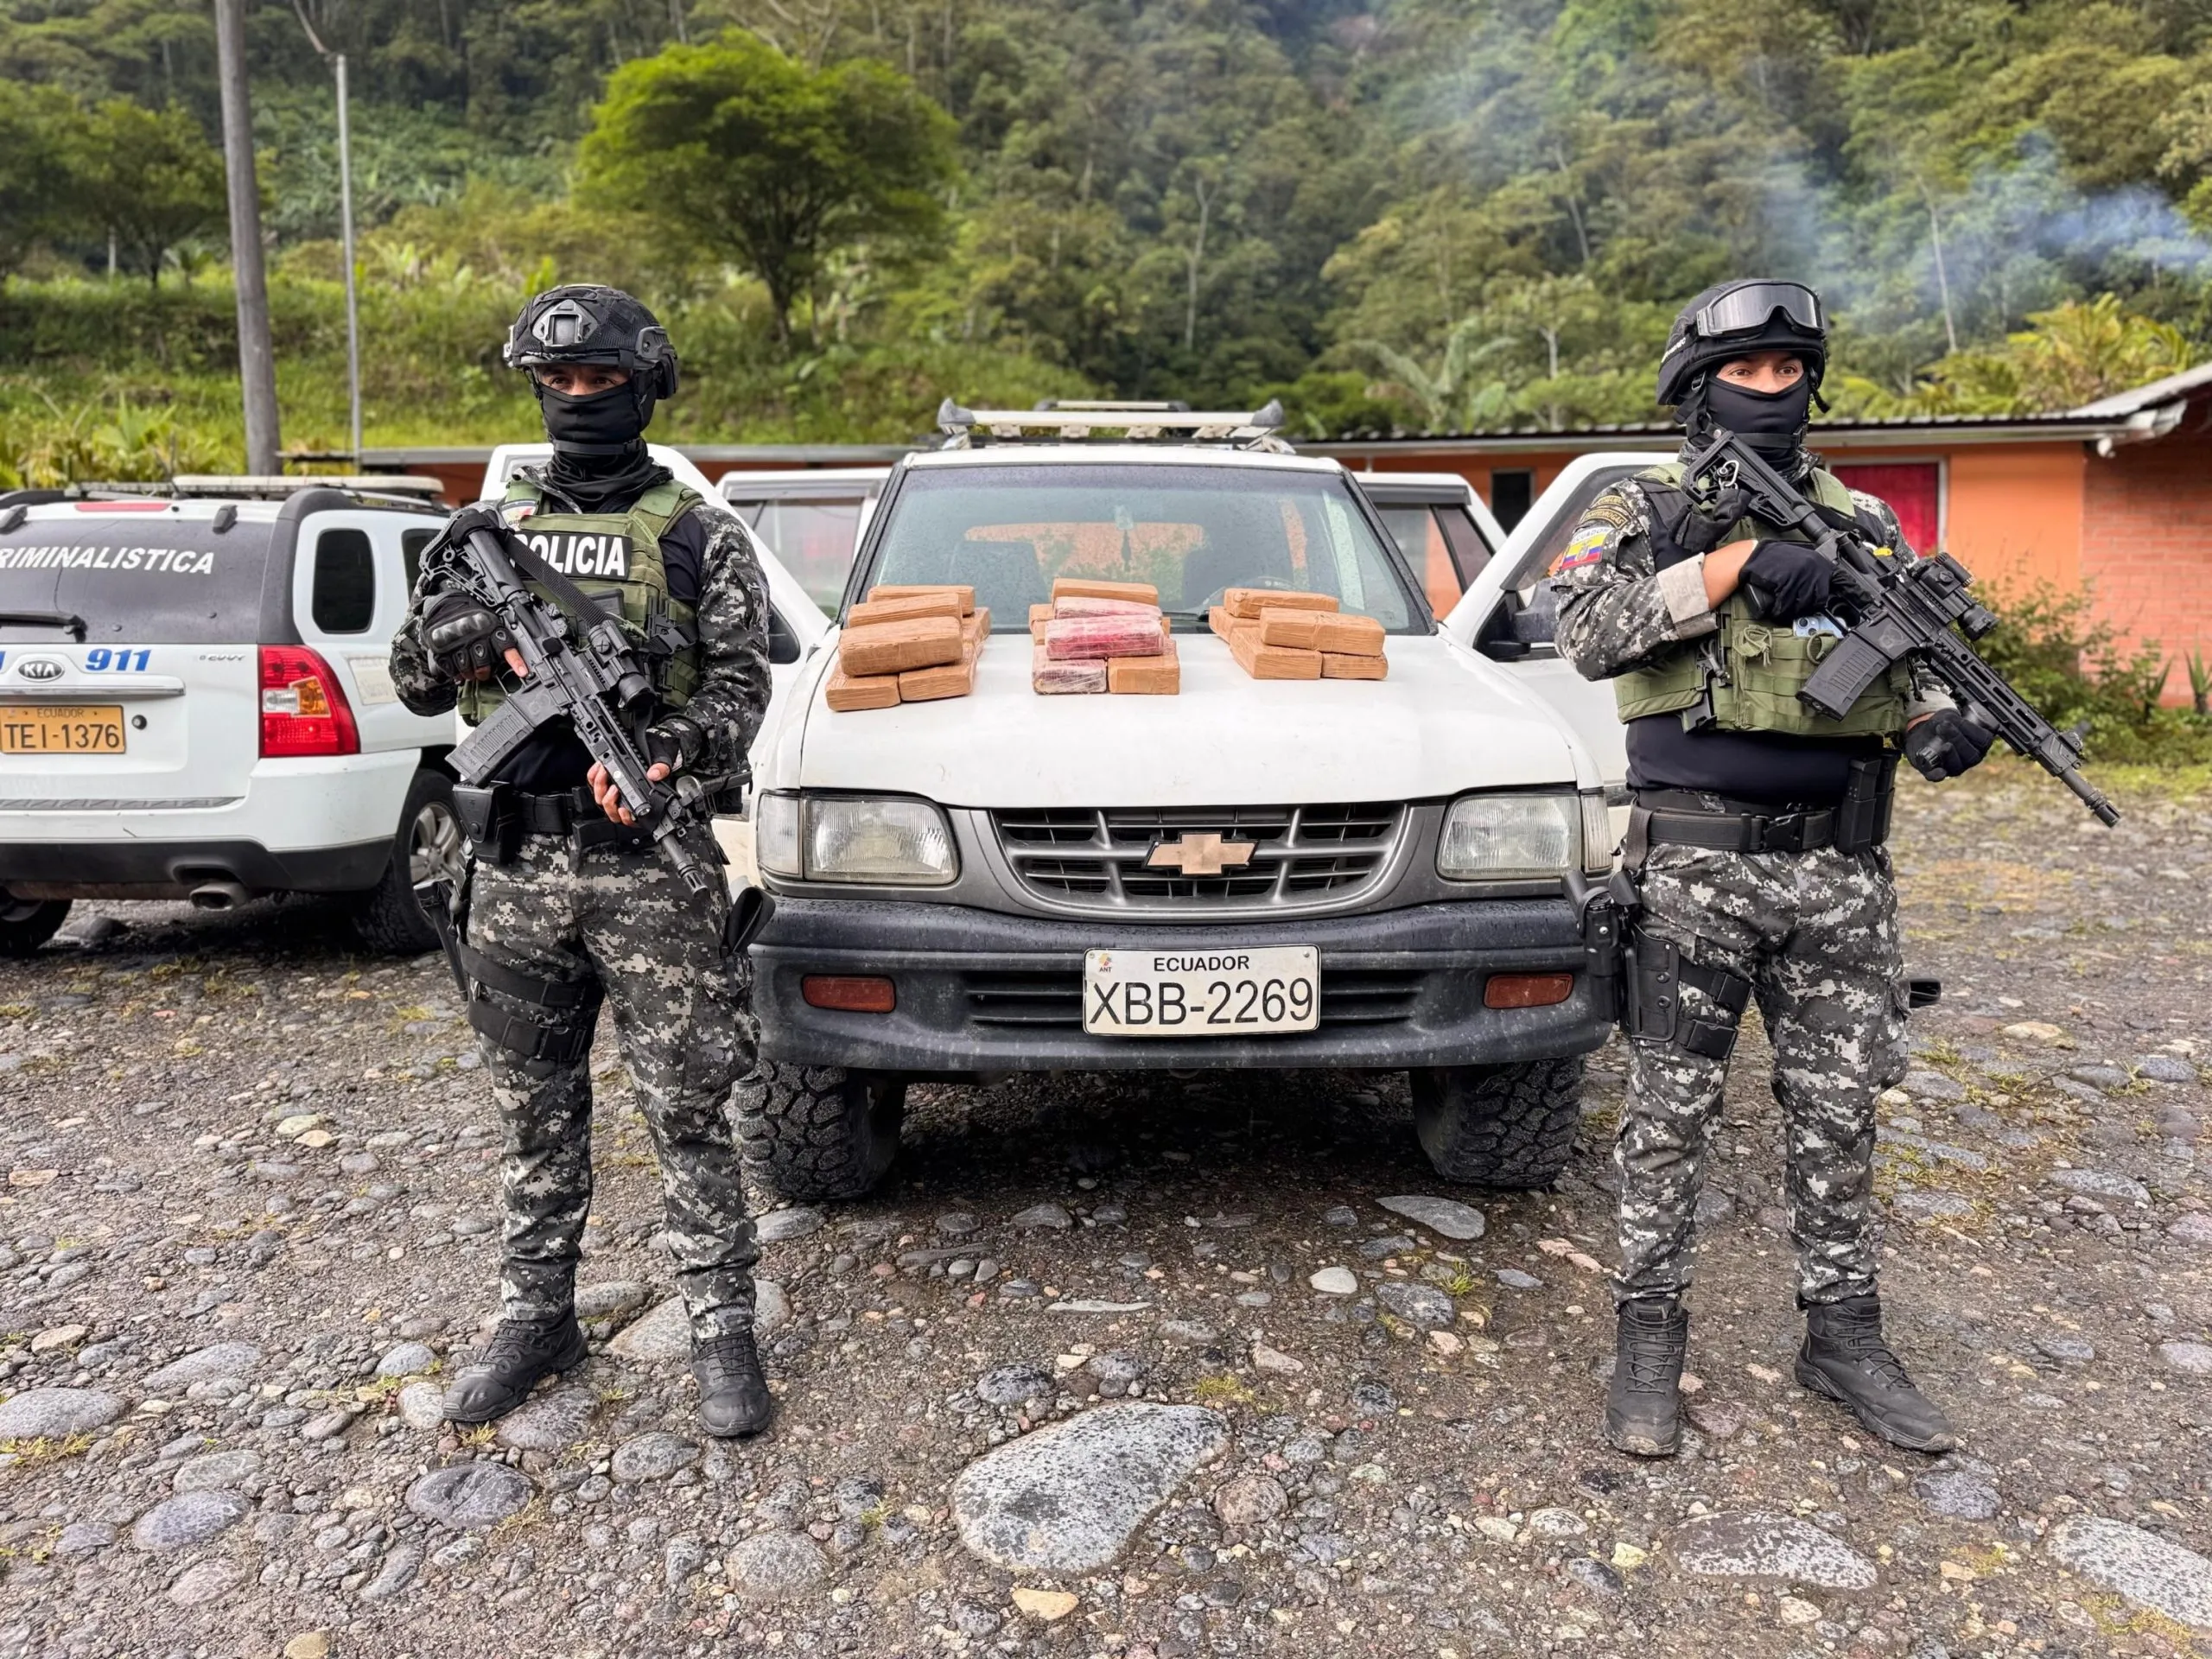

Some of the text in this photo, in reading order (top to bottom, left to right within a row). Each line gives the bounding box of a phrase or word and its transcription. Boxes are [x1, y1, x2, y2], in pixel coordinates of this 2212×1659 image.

[85, 648, 151, 671] 911
[23, 663, 56, 677] KIA
[37, 709, 85, 718] ECUADOR
[4, 724, 120, 748] TEI-1376
[1154, 956, 1249, 972] ECUADOR
[1089, 977, 1313, 1025] XBB-2269
